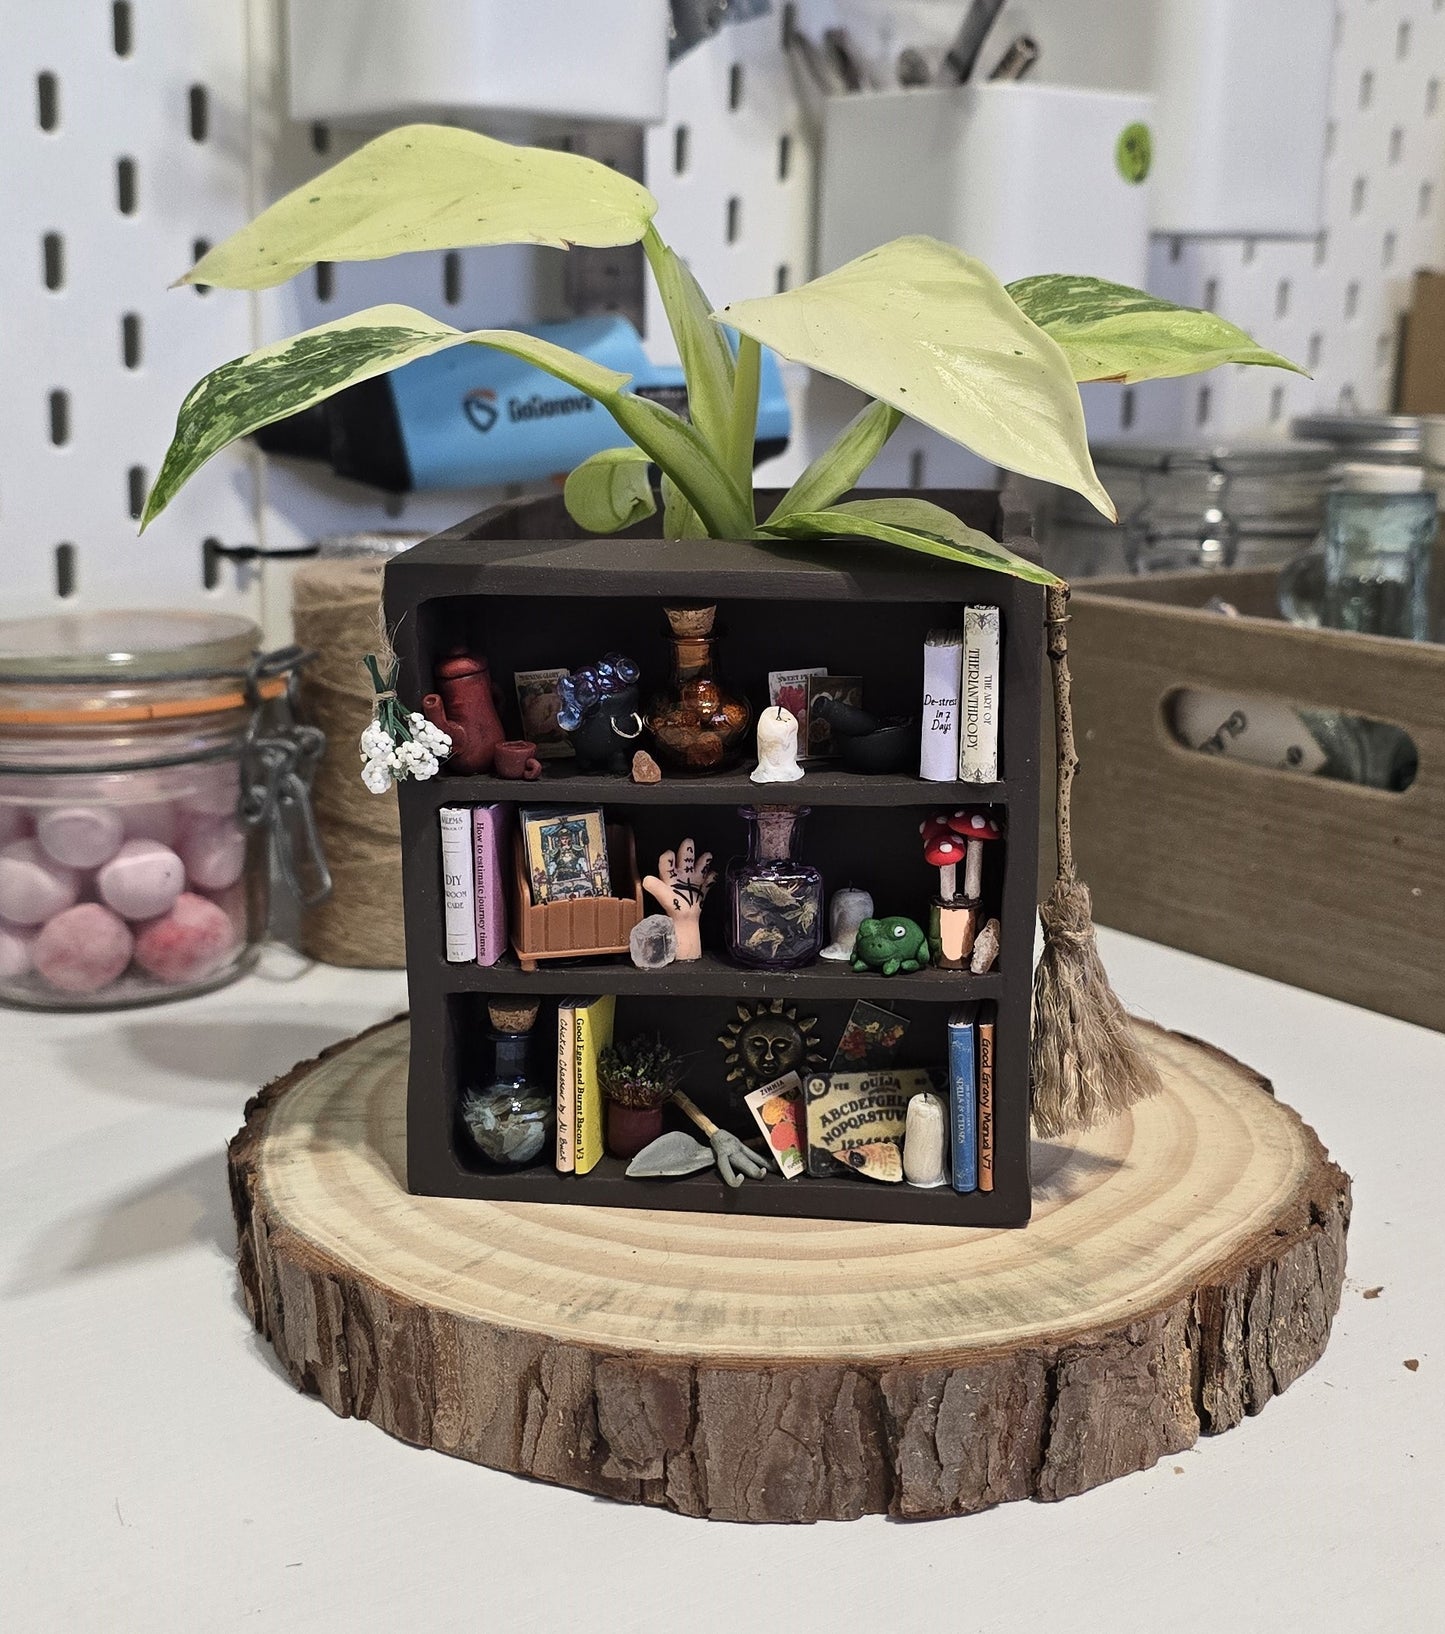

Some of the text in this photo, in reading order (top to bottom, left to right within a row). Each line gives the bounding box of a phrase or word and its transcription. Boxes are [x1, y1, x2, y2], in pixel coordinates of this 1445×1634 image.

[984, 675, 993, 690] THE
[924, 694, 957, 706] De-stress
[966, 648, 981, 750] THERIANTHROPY
[983, 693, 992, 709] ART
[946, 712, 950, 722] 7
[931, 719, 952, 734] Days
[446, 874, 462, 886] DIY
[476, 822, 488, 956] How to estimate journey times
[576, 1018, 584, 1160] Good Eggs and Burnt Bacon V3
[760, 1079, 785, 1096] ZINNIA
[860, 1076, 901, 1092] OUIJA
[558, 1104, 567, 1114] by
[980, 1038, 992, 1170] Good Gravy Manual V7
